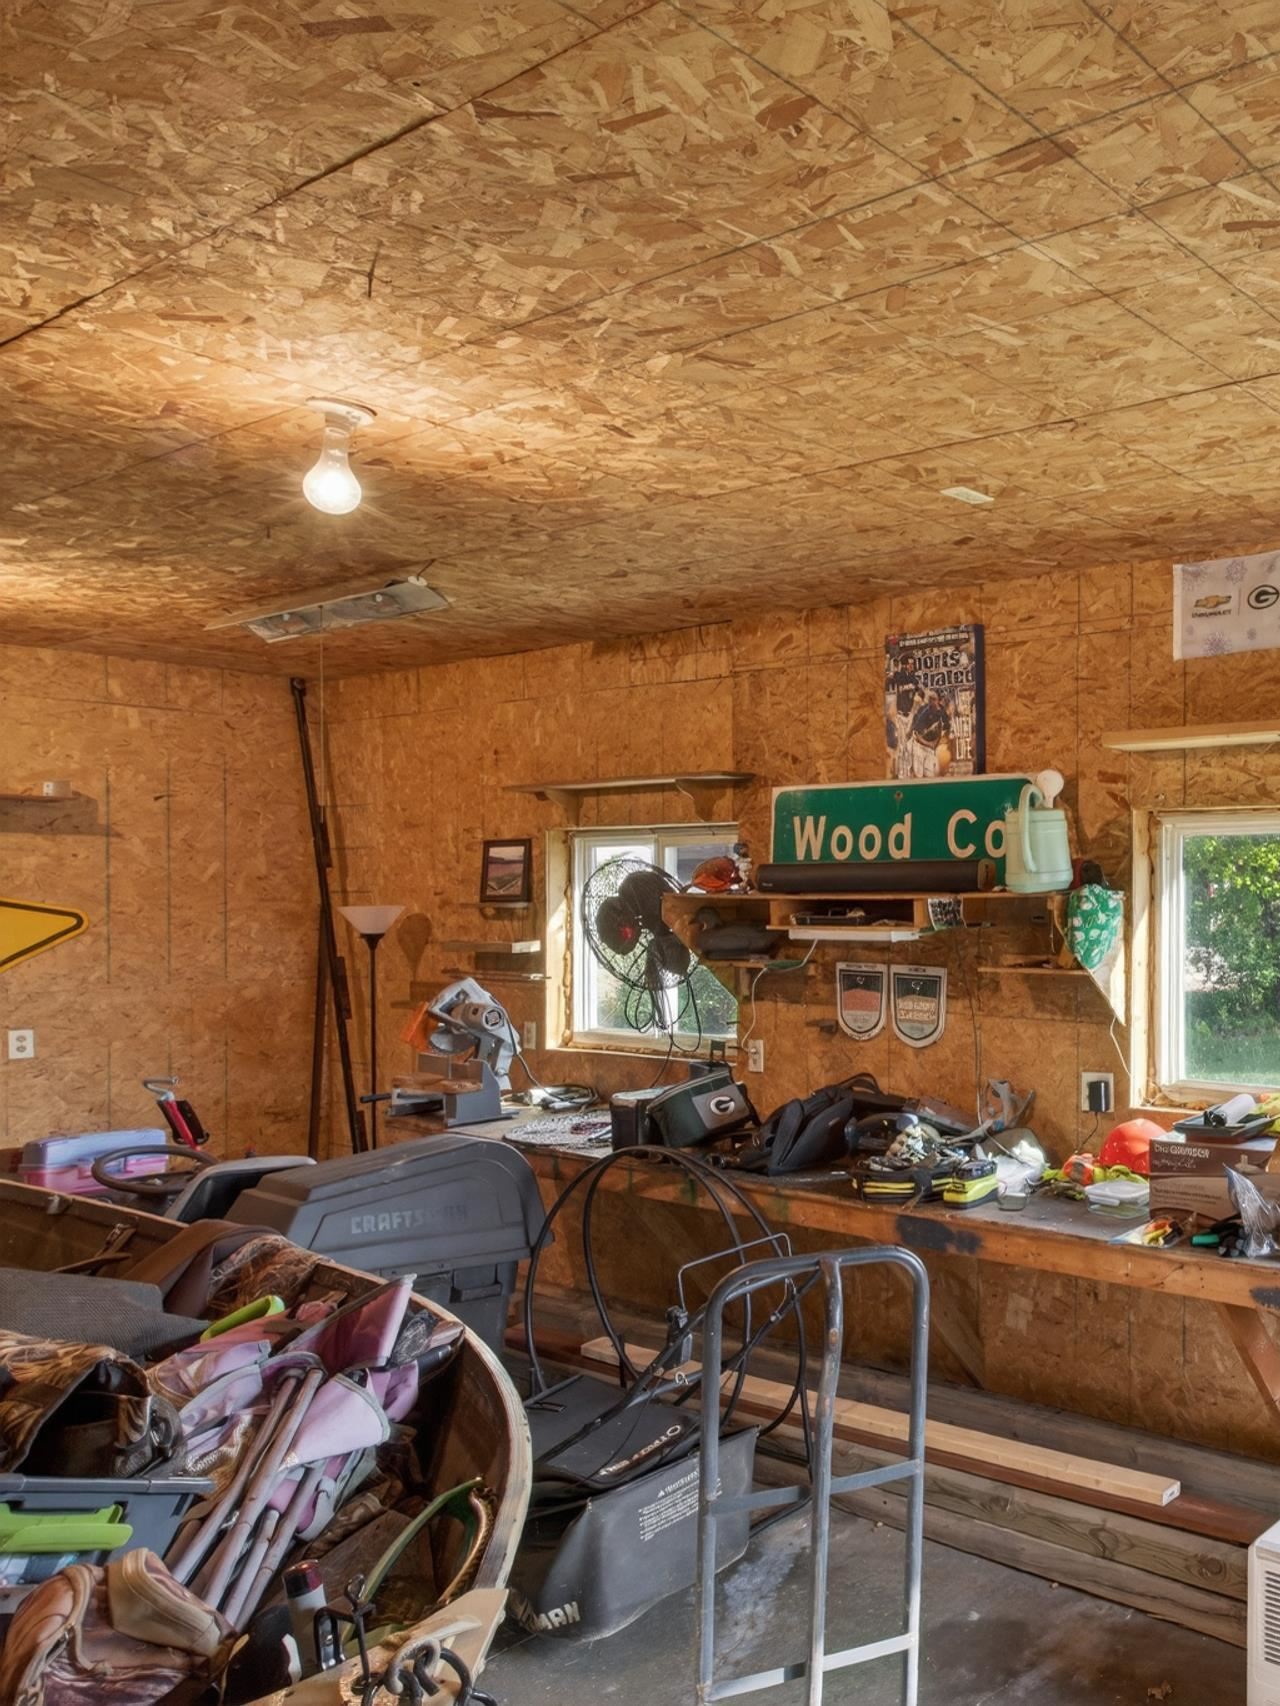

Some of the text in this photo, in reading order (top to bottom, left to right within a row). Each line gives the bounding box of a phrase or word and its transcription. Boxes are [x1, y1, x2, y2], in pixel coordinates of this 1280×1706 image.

[792, 808, 1007, 862] Wood Co
[351, 1204, 467, 1234] CRAFTS
